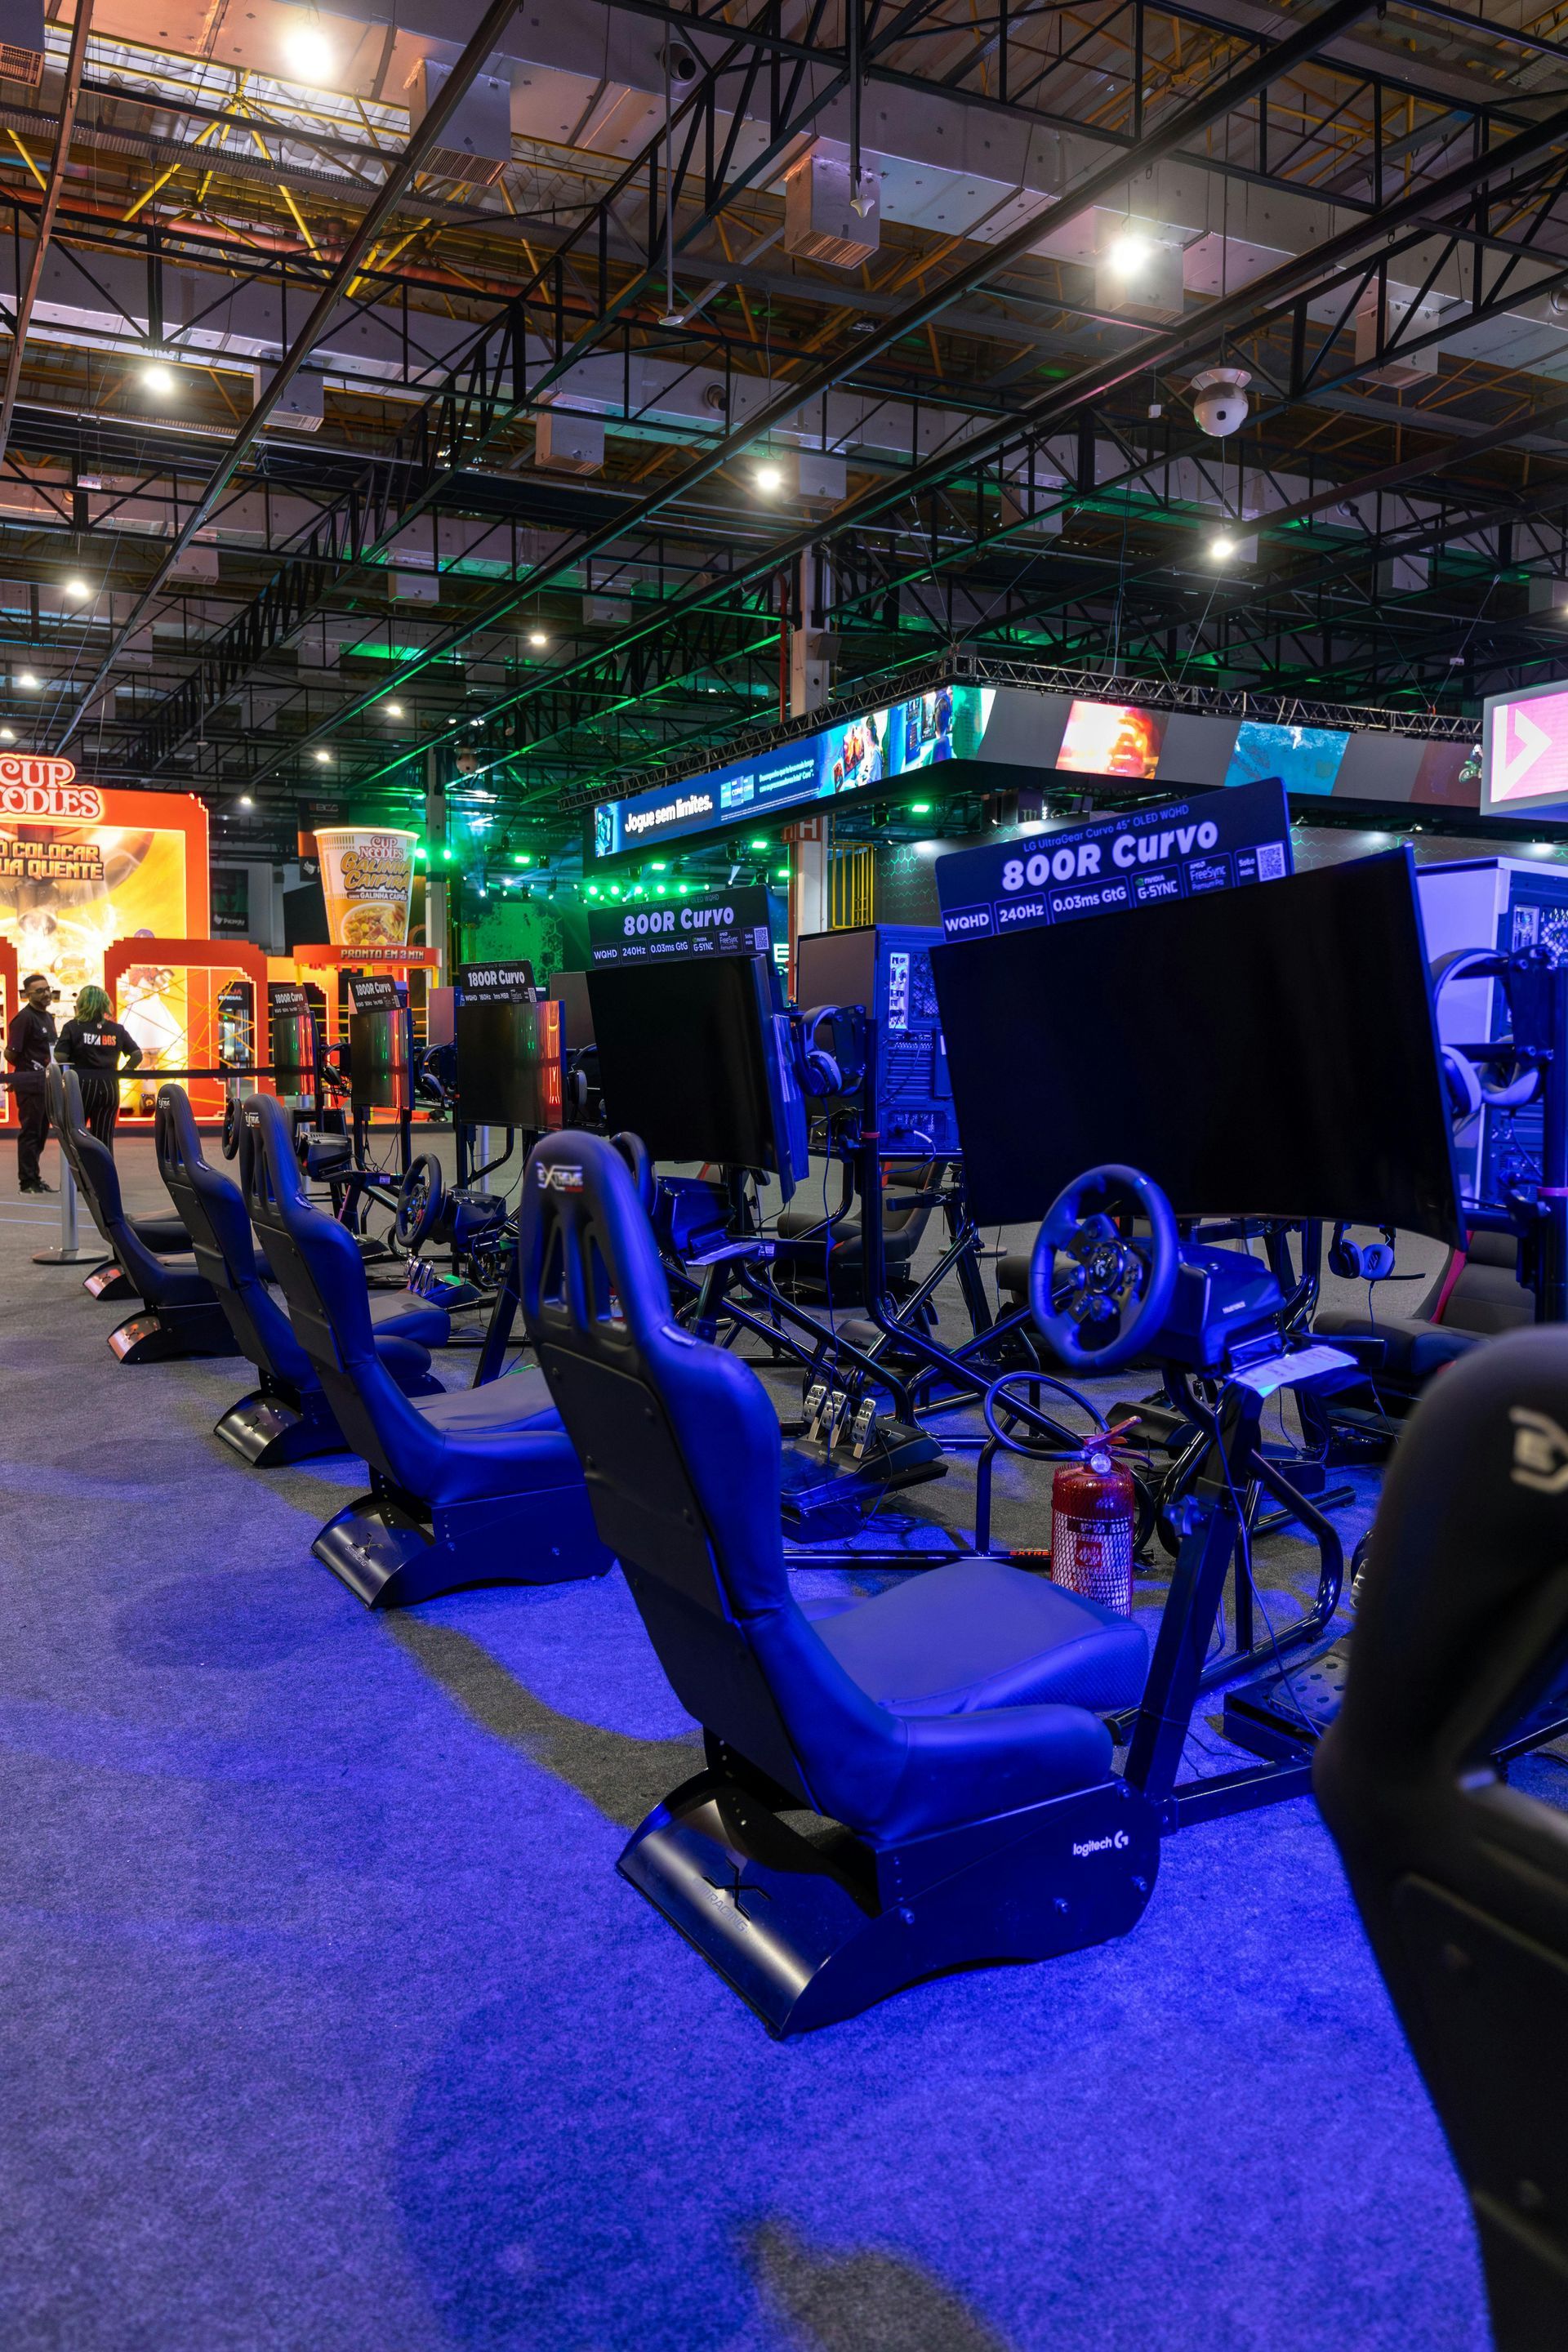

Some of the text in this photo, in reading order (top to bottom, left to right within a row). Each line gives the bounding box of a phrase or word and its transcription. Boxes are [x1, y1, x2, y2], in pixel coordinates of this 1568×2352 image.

[0, 757, 71, 788] CUP
[0, 785, 100, 818] ODLES
[625, 811, 655, 833] Jogue
[655, 804, 676, 824] sem
[676, 795, 713, 818] limites.
[1023, 841, 1036, 853] LG
[1038, 832, 1084, 849] UltraGear
[1085, 825, 1114, 838] Curvo
[1133, 812, 1158, 827] OLED
[1160, 805, 1189, 818] WQHD
[371, 836, 398, 848] CUP
[12, 842, 100, 862] COLOCAR
[1002, 822, 1218, 891] 800R Curvo
[28, 859, 103, 880] QUENTE
[1190, 866, 1227, 882] FreeSync
[344, 870, 411, 893] CAIPIRA
[1138, 880, 1178, 899] G-SYNC
[1053, 886, 1127, 912] 0.03ms GtG
[624, 906, 734, 936] 800R Curvo
[999, 903, 1045, 923] 240Hz
[945, 913, 990, 933] WQHD
[650, 942, 688, 953] 0.03ms GtG
[693, 942, 714, 951] G-SYNC
[719, 936, 738, 945] FreeSync
[341, 949, 424, 960] PRONTO EM 3 MIN
[594, 950, 617, 960] WQHD
[622, 947, 646, 956] 240Hz
[468, 969, 525, 987] 1800R Curvo
[274, 991, 304, 1004] 1800R Curvo
[355, 981, 391, 996] 1800R Curvo
[83, 1032, 100, 1045] TEAM
[1073, 1836, 1112, 1857] logitech
